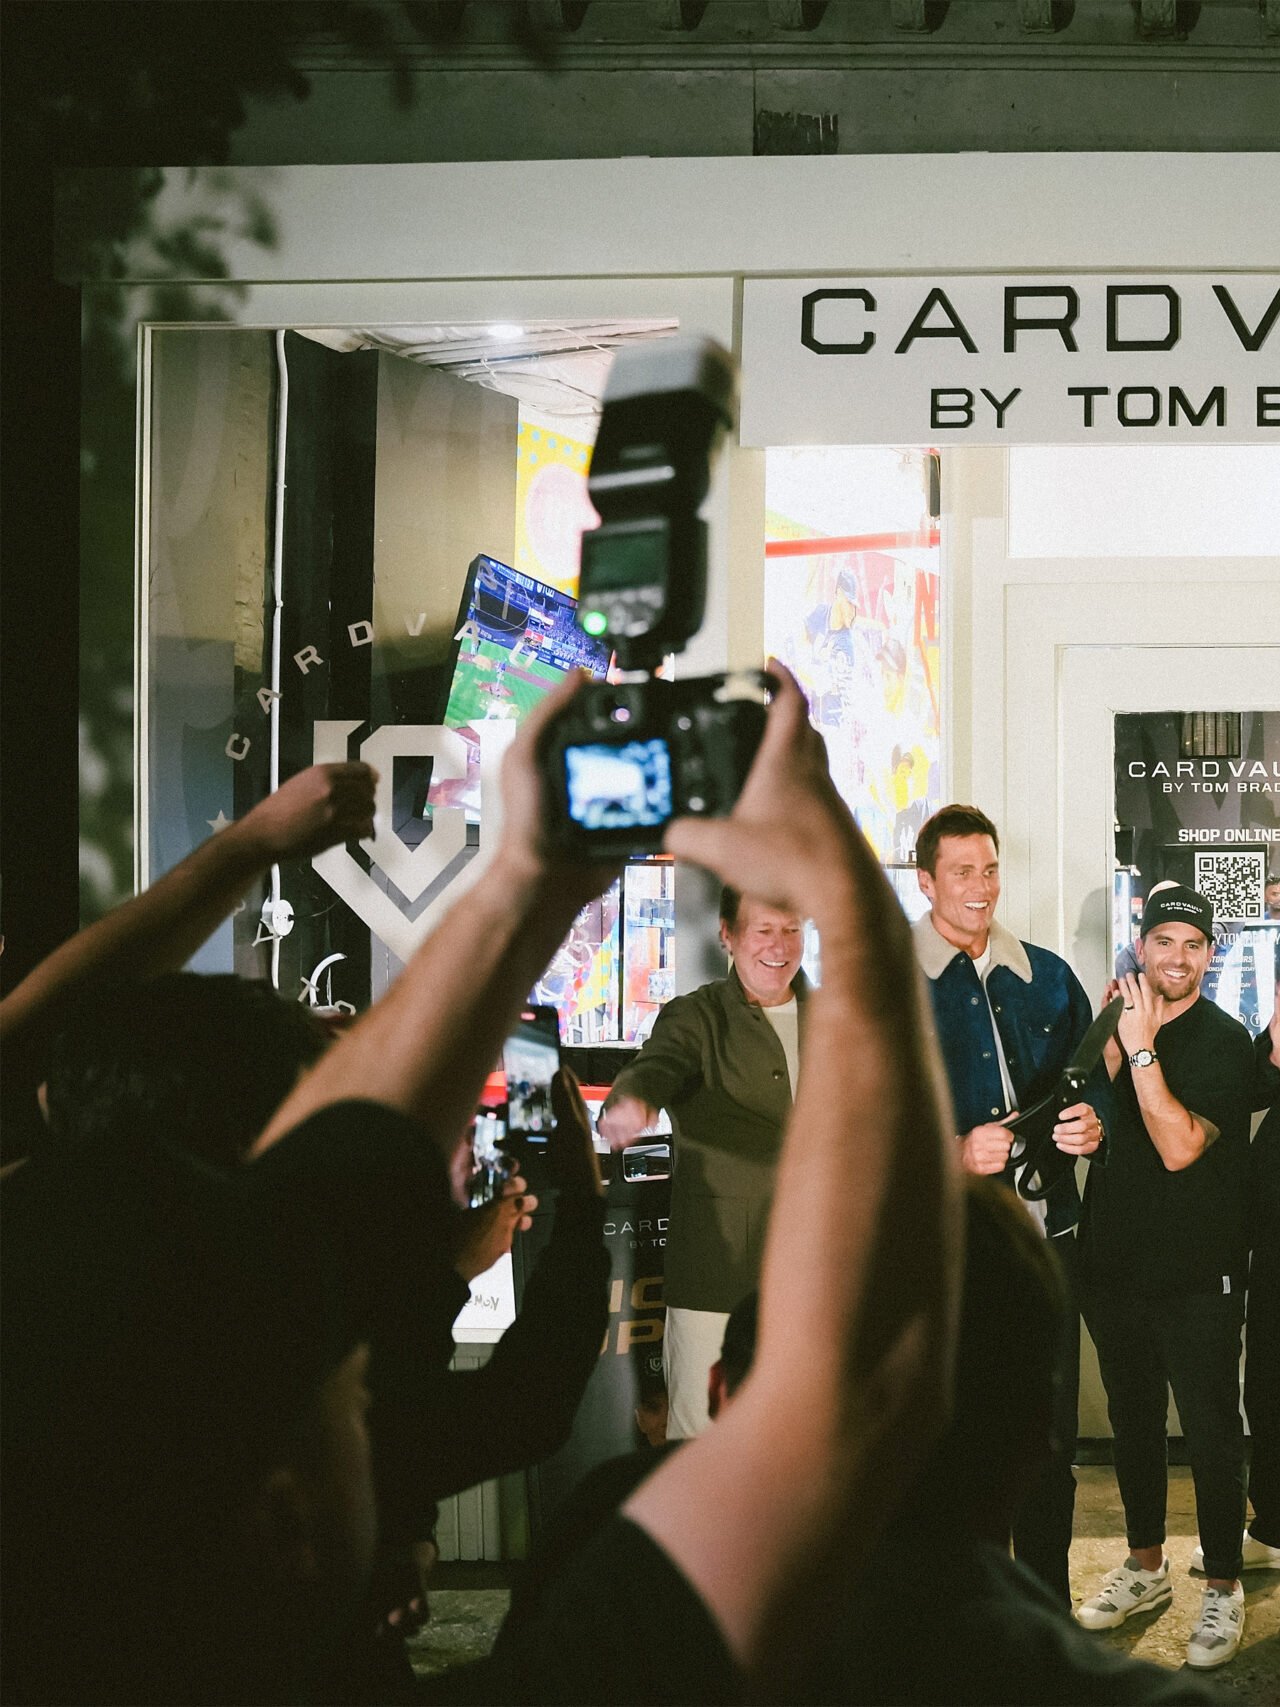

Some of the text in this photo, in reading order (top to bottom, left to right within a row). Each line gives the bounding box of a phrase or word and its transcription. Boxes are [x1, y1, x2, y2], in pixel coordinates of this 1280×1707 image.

[930, 387, 1021, 430] BY
[1067, 386, 1228, 428] TOM
[1163, 782, 1184, 793] BY
[1191, 782, 1229, 793] TOM
[1178, 828, 1280, 842] SHOP ONLINE
[651, 1238, 667, 1248] TO
